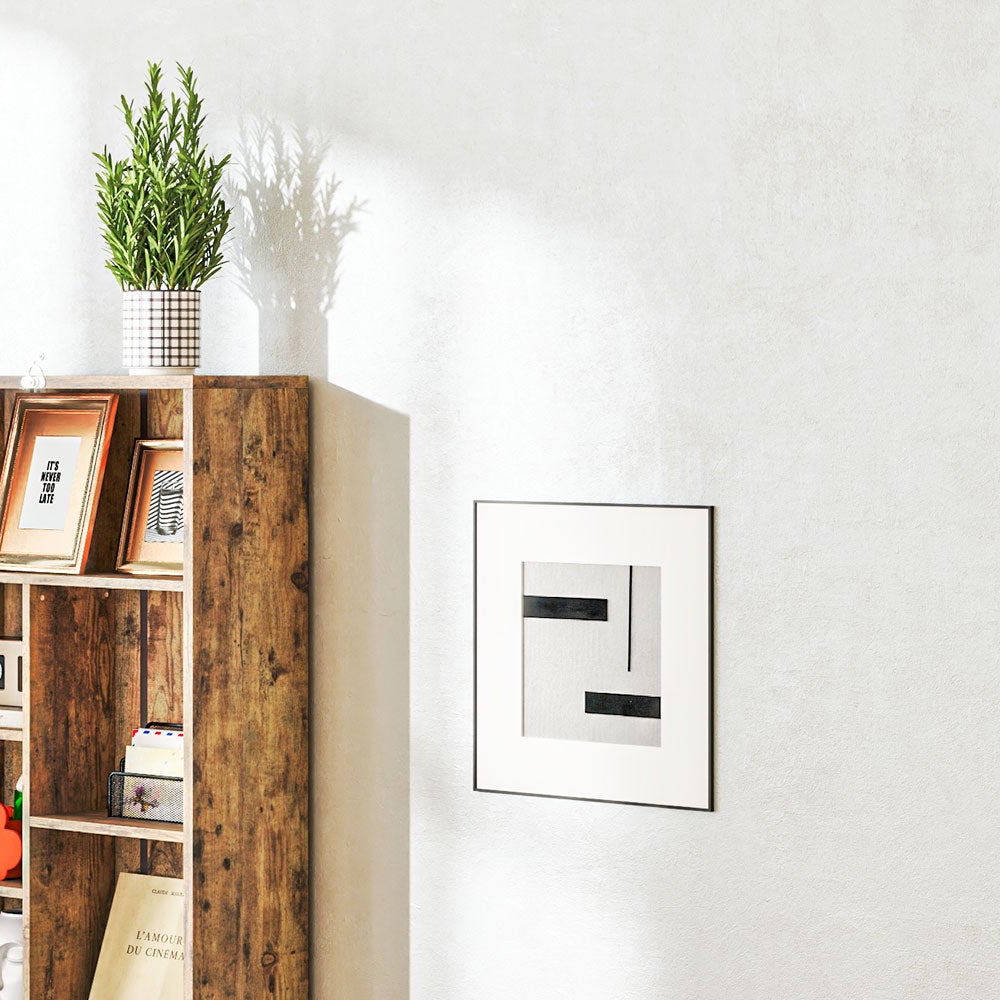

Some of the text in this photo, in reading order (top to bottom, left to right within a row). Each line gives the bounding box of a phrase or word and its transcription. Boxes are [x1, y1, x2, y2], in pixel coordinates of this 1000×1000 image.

[40, 471, 61, 482] NEVER
[42, 482, 55, 493] TOO
[39, 493, 55, 504] LATE
[136, 930, 183, 945] L'AMOUR
[126, 944, 142, 955] DU
